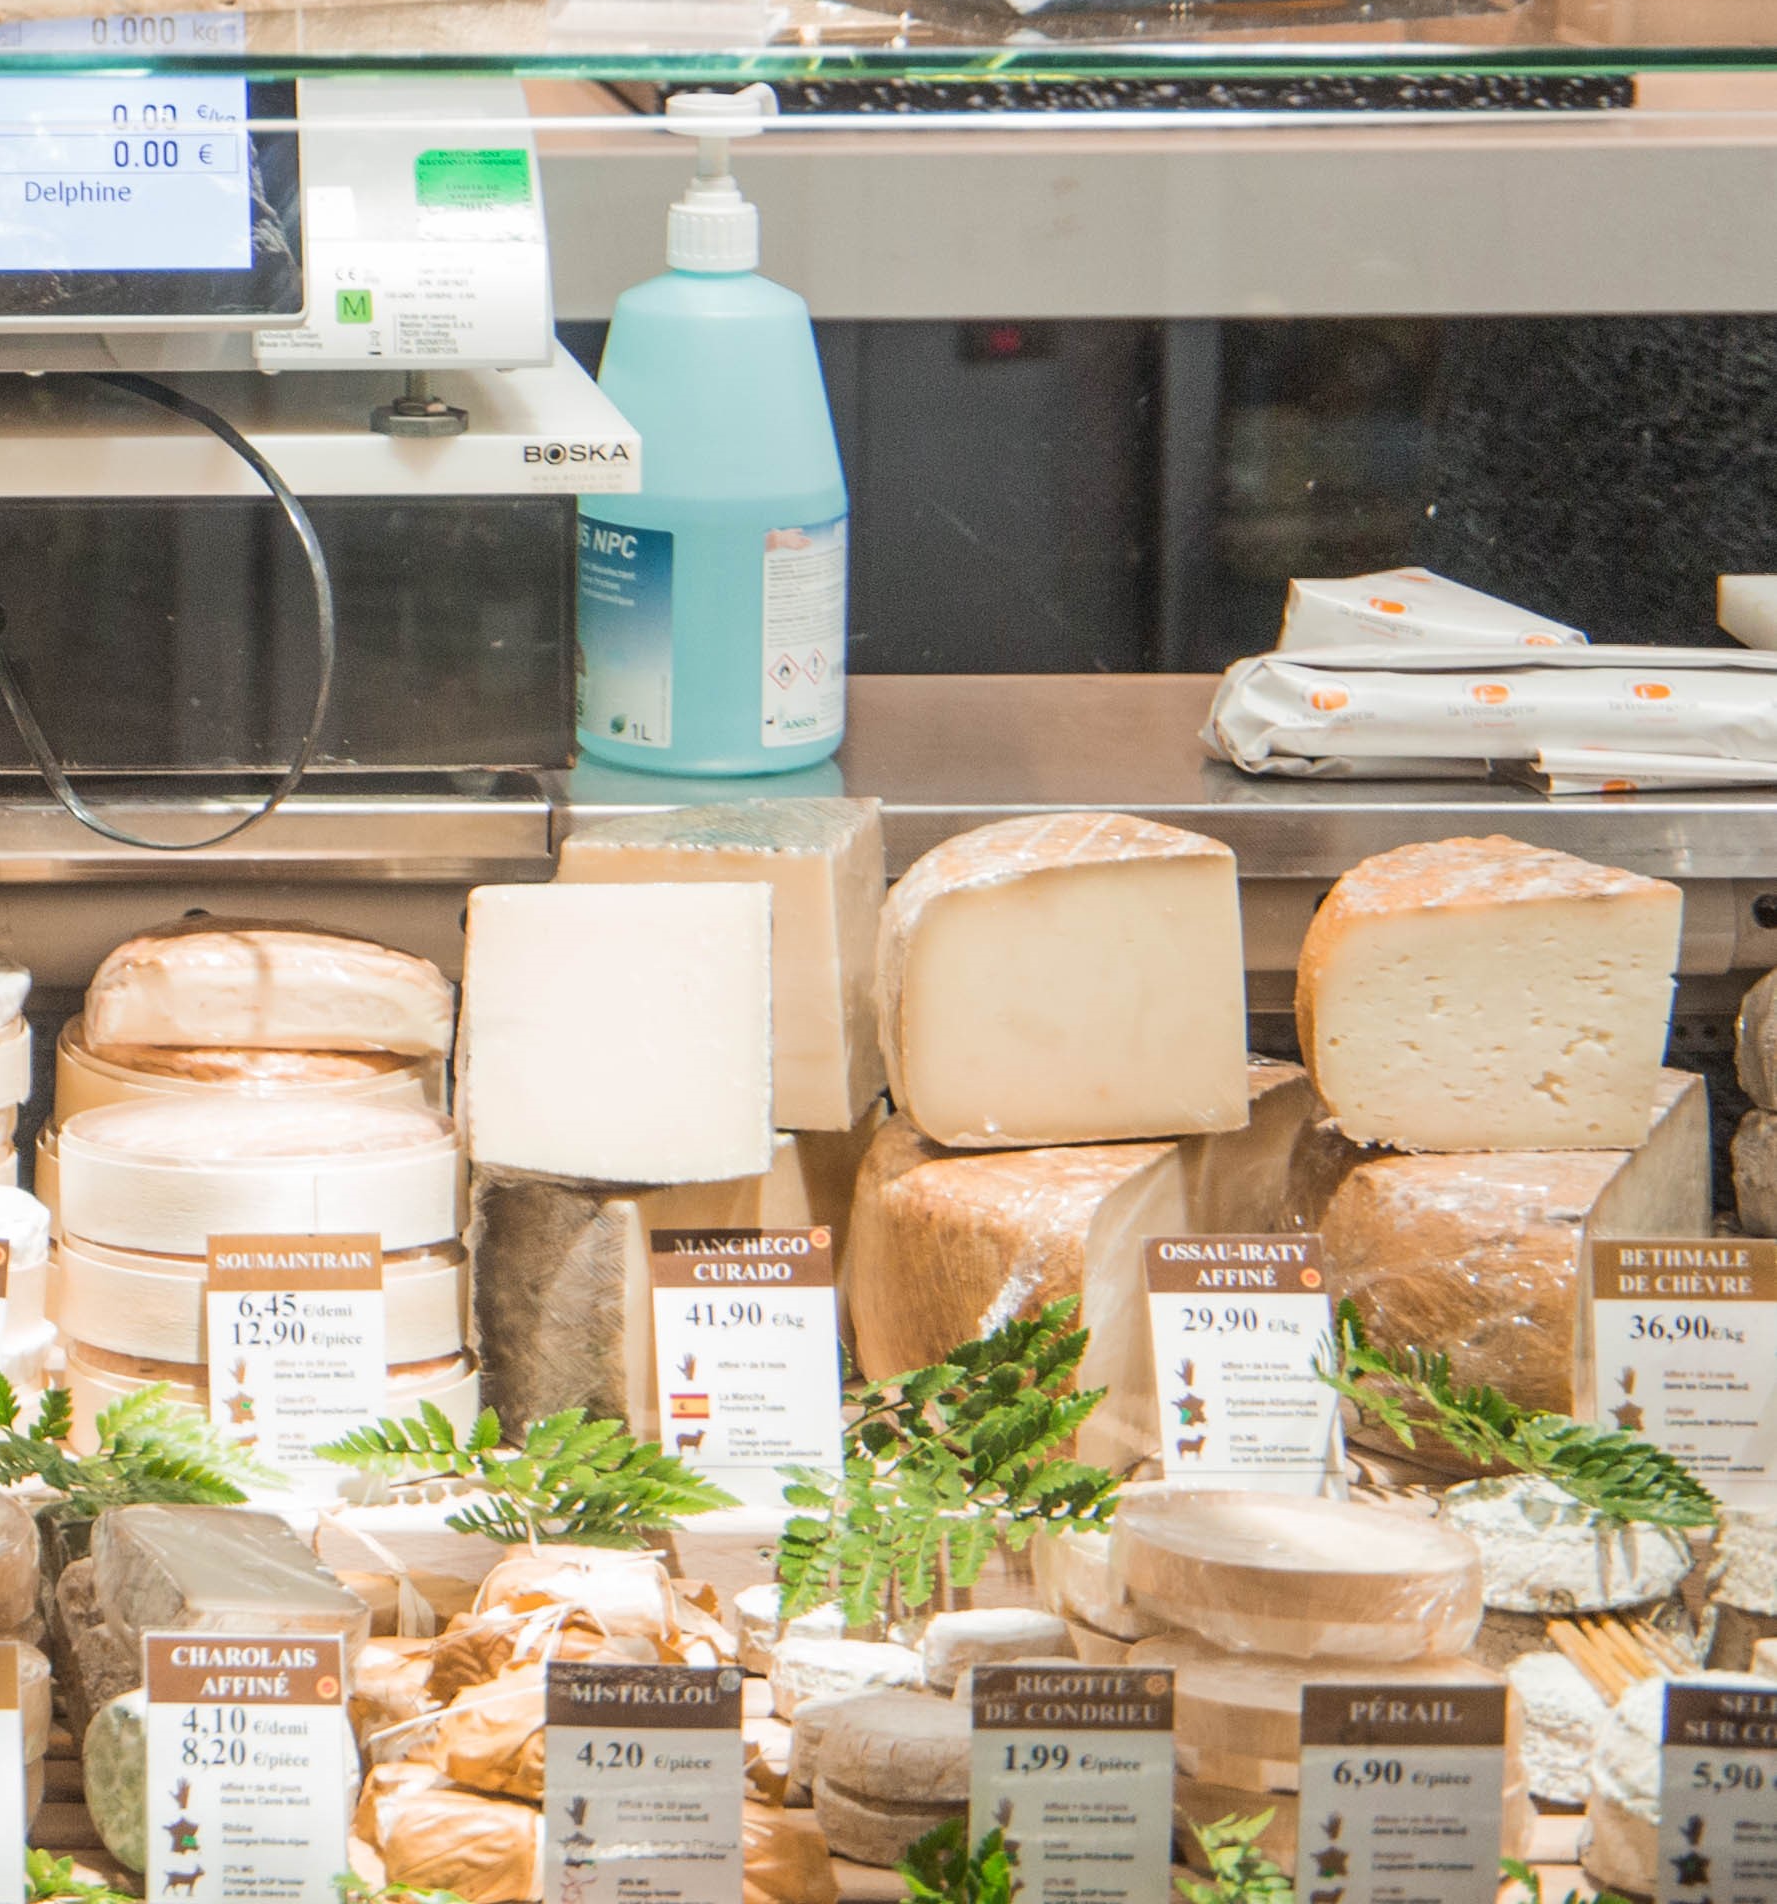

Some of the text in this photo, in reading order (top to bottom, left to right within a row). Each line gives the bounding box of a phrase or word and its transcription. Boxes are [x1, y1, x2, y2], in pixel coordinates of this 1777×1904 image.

[92, 17, 176, 45] 0.000
[114, 141, 213, 167] 0.00 €
[25, 181, 132, 206] Delphine
[343, 296, 366, 316] M
[524, 443, 630, 464] BOSKA
[593, 529, 638, 559] NPC
[674, 1237, 809, 1255] MANCHEGO
[1158, 1243, 1307, 1262] OSSAU-IRATY
[1619, 1248, 1749, 1267] BETHMALE
[216, 1252, 373, 1270] SOUMAINTRAIN
[693, 1263, 792, 1281] CURADO
[1196, 1266, 1277, 1287] AFFINÉ
[1618, 1271, 1753, 1294] DE CHÈVRE
[238, 1293, 297, 1320] 6,45
[685, 1302, 805, 1328] 41,90 €/kg
[1181, 1308, 1300, 1335] 29,90 €/kg
[232, 1321, 305, 1349] 12,90
[170, 1646, 317, 1668] CHAROLAIS
[201, 1672, 290, 1696] AFFINÉ
[569, 1683, 720, 1705] MISTRALOU
[1015, 1675, 1131, 1695] RIGOTTE
[181, 1706, 308, 1737] 4,10 €/demi
[985, 1703, 1159, 1723] DE CONDRIEU
[1349, 1695, 1463, 1723] PÉRAIL
[182, 1738, 310, 1769] 8,20 €/pièce
[576, 1741, 712, 1772] 4,20 €/pièce
[1005, 1744, 1141, 1774] 1,99 €/pièce
[1332, 1760, 1403, 1789] 6,90
[1692, 1762, 1764, 1794] 5,90
